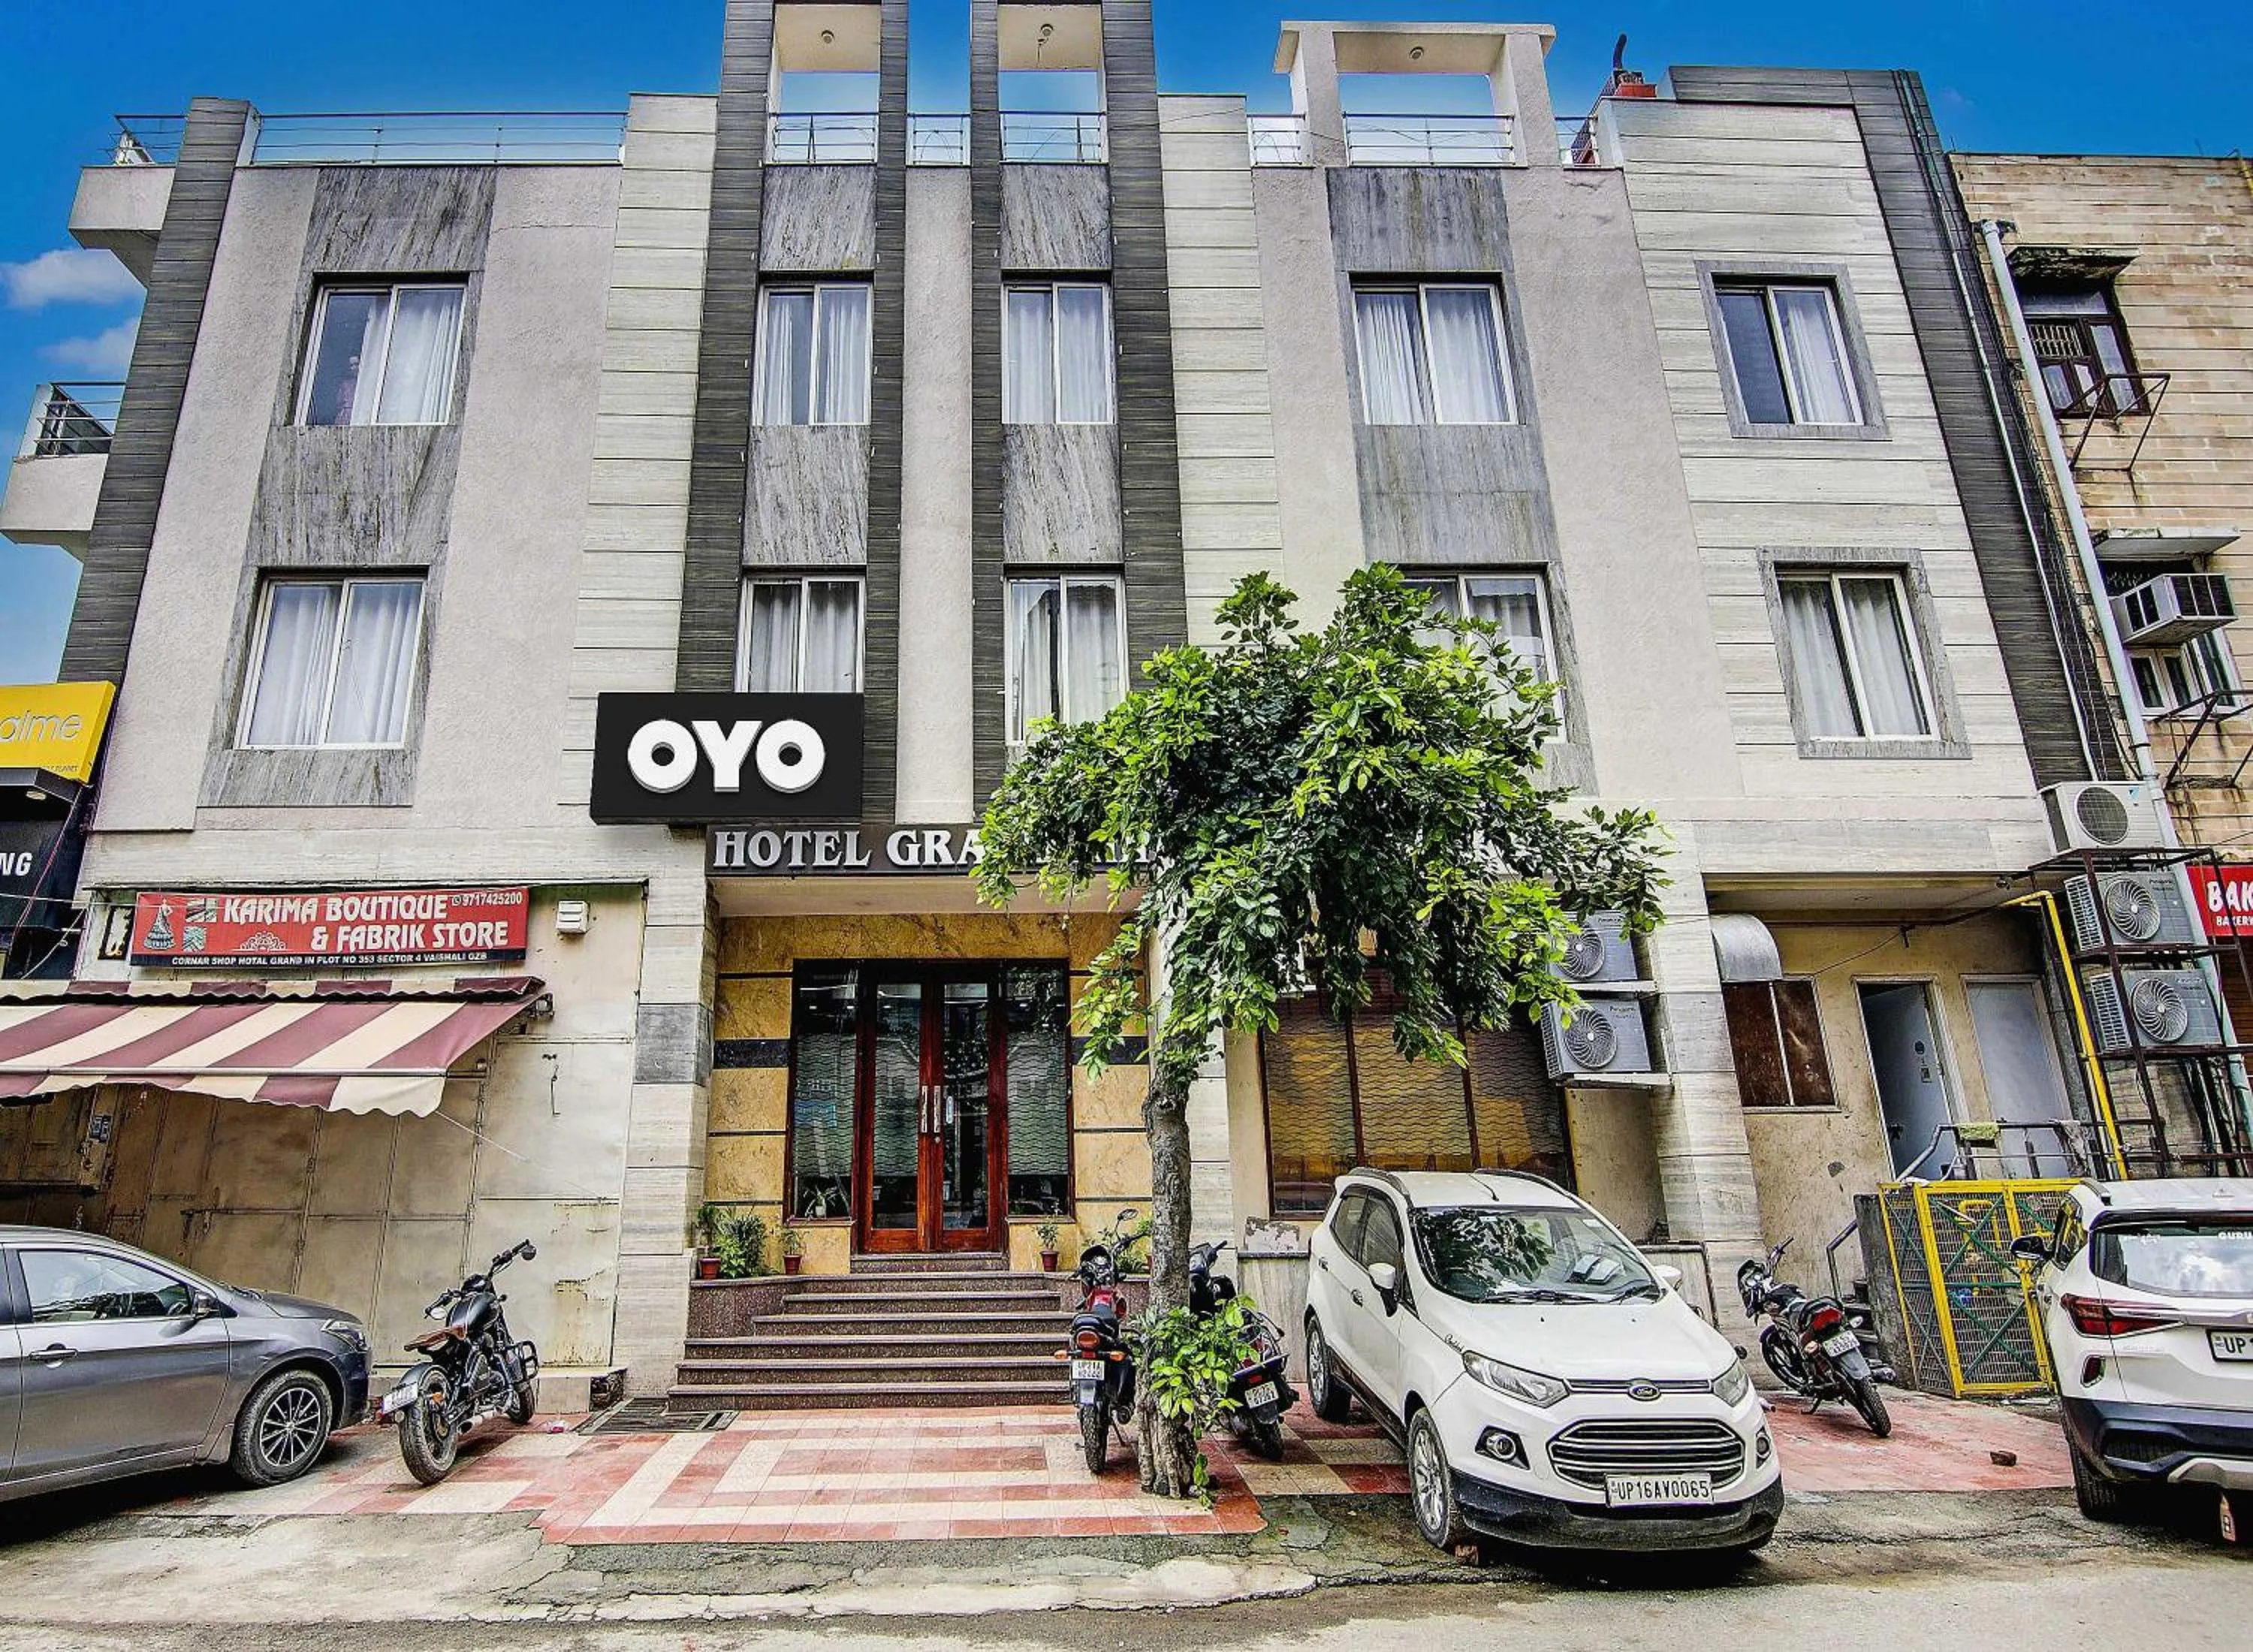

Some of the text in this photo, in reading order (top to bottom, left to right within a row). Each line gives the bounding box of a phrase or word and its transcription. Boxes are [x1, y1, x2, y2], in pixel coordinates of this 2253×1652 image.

[628, 719, 826, 794] OYO
[713, 830, 873, 868] HOTEL
[223, 894, 448, 925] KARIMA BOUTIQUE
[462, 892, 523, 906] 9717425200
[310, 921, 508, 953] & FABRIK STORE
[172, 957, 210, 966] CORNAR
[211, 957, 236, 965] SHOP
[238, 957, 268, 965] HOTAL
[270, 956, 303, 965] GRAND
[304, 956, 315, 964] IN
[316, 956, 341, 964] PLOT
[358, 955, 375, 963] 353
[376, 954, 414, 963] SECTOR
[423, 953, 466, 962] VAISHALI
[2218, 1231, 2252, 1240] GURU
